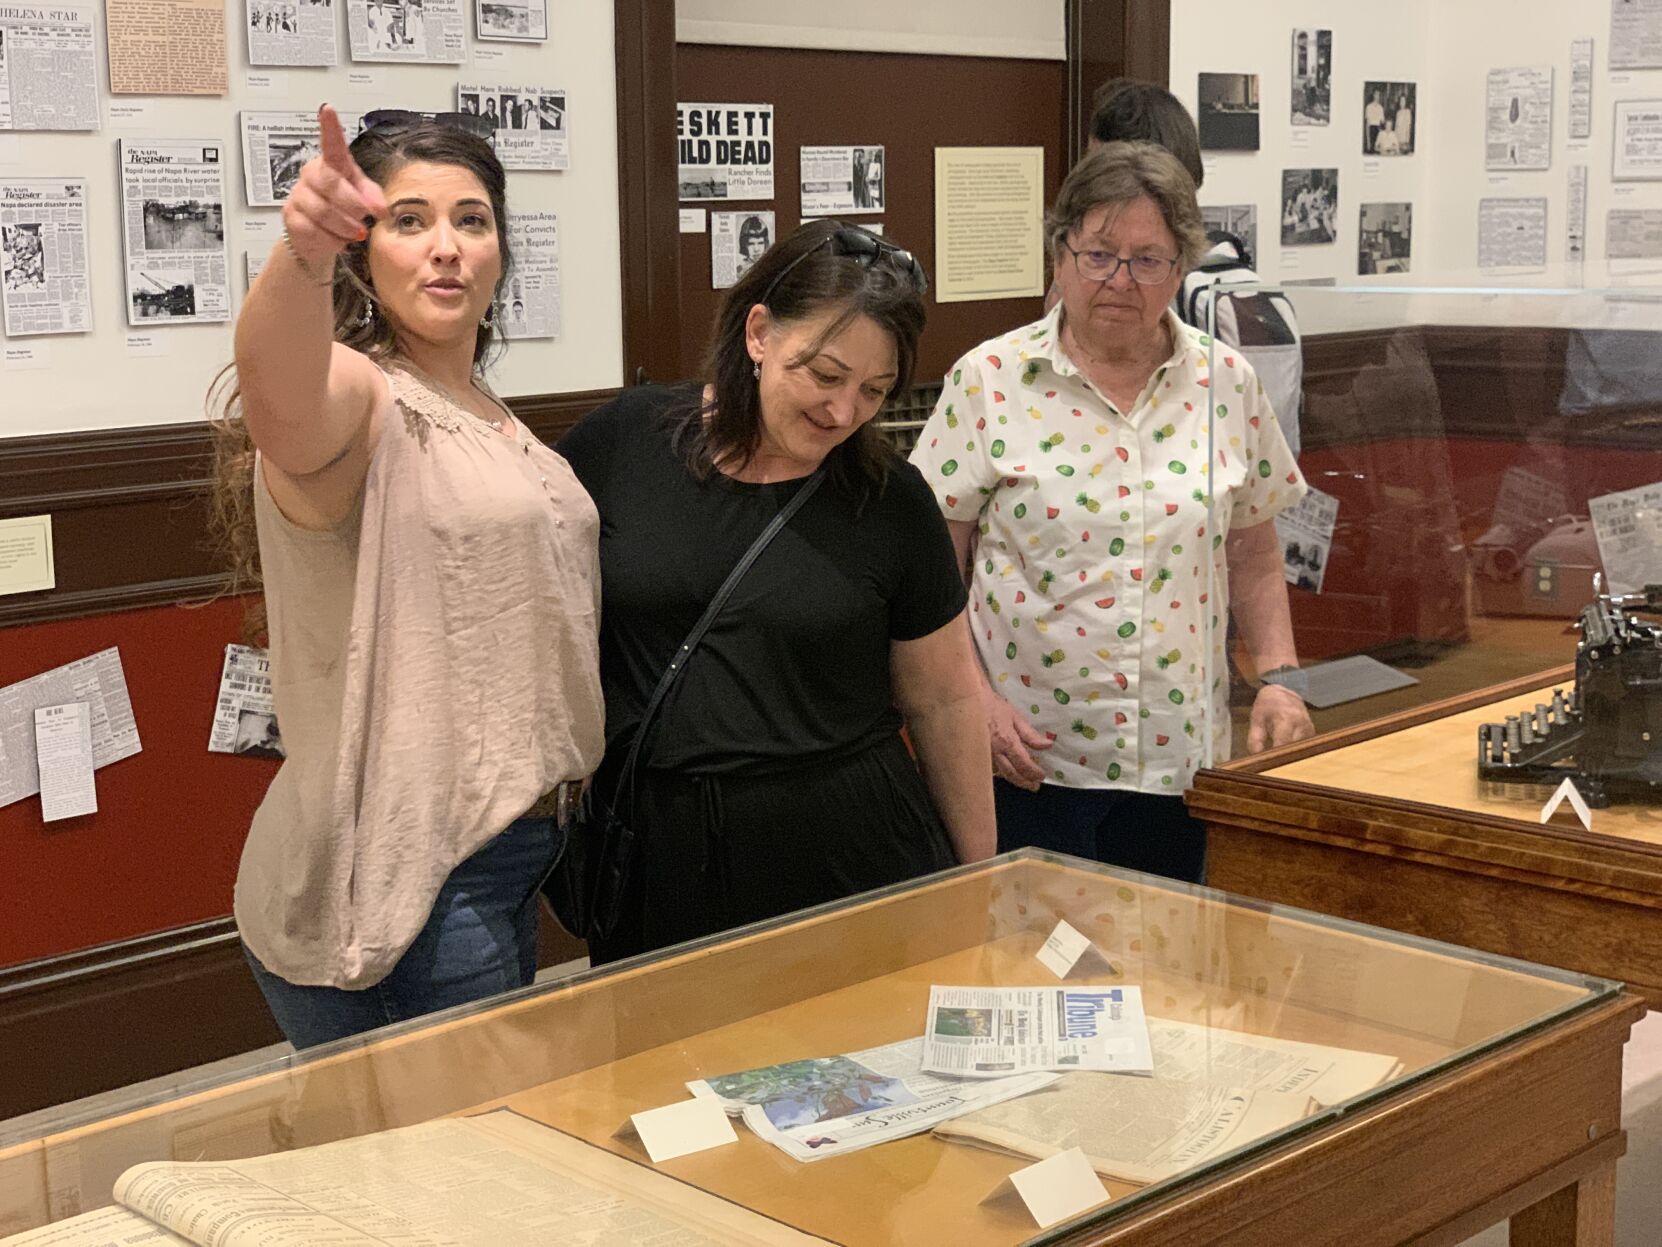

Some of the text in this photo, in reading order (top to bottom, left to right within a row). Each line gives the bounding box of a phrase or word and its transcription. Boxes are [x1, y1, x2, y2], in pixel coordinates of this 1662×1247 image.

[0, 8, 79, 21] HELENA STAR
[677, 110, 771, 137] ESKETT
[504, 138, 535, 149] Register
[716, 140, 772, 165] DEAD
[130, 154, 173, 165] Register
[728, 168, 772, 177] Rancher Finds
[728, 177, 745, 186] Little
[507, 212, 557, 222] erryessa Area
[524, 224, 556, 234] Convicts
[525, 238, 556, 248] Register
[1064, 989, 1124, 1039] Tribune
